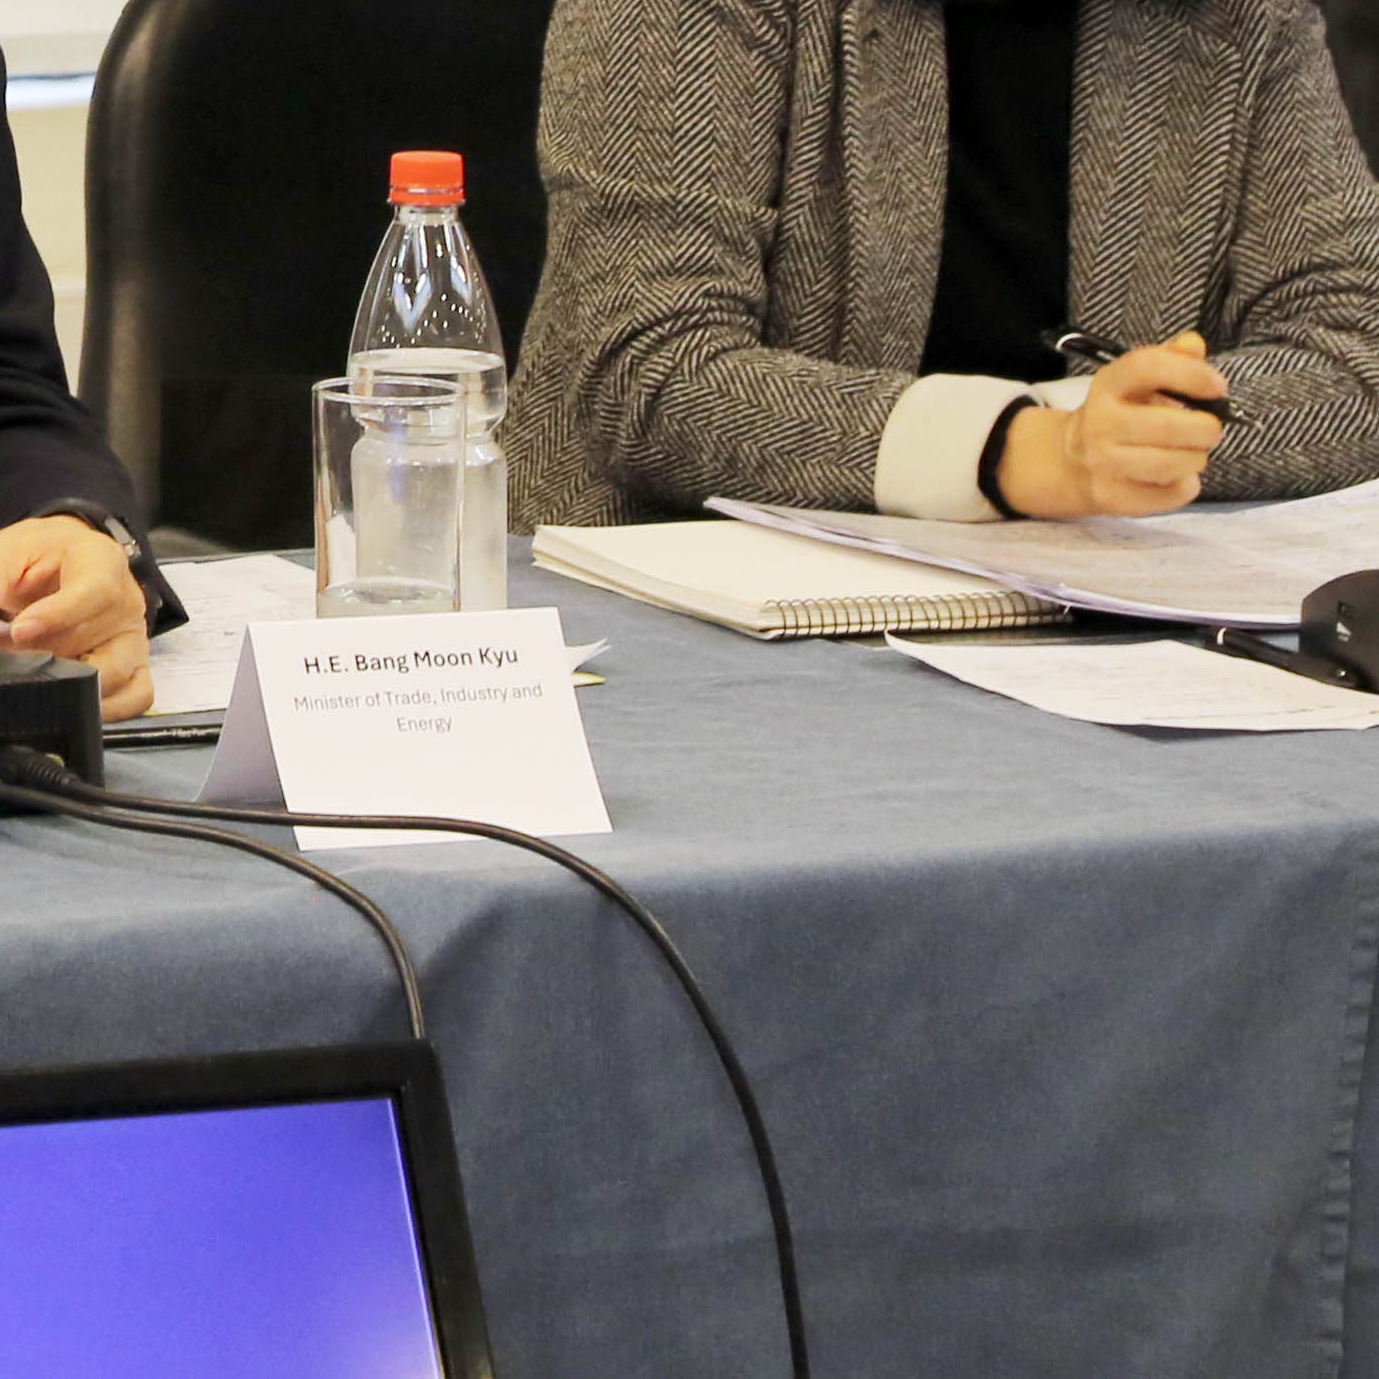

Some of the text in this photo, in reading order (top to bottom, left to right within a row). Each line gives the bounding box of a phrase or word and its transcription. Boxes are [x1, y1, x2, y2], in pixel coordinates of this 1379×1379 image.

[304, 647, 518, 675] H.E. Bang Moon Kyu
[294, 683, 543, 712] Minister of Trade, Industry and
[396, 716, 453, 734] Energy
